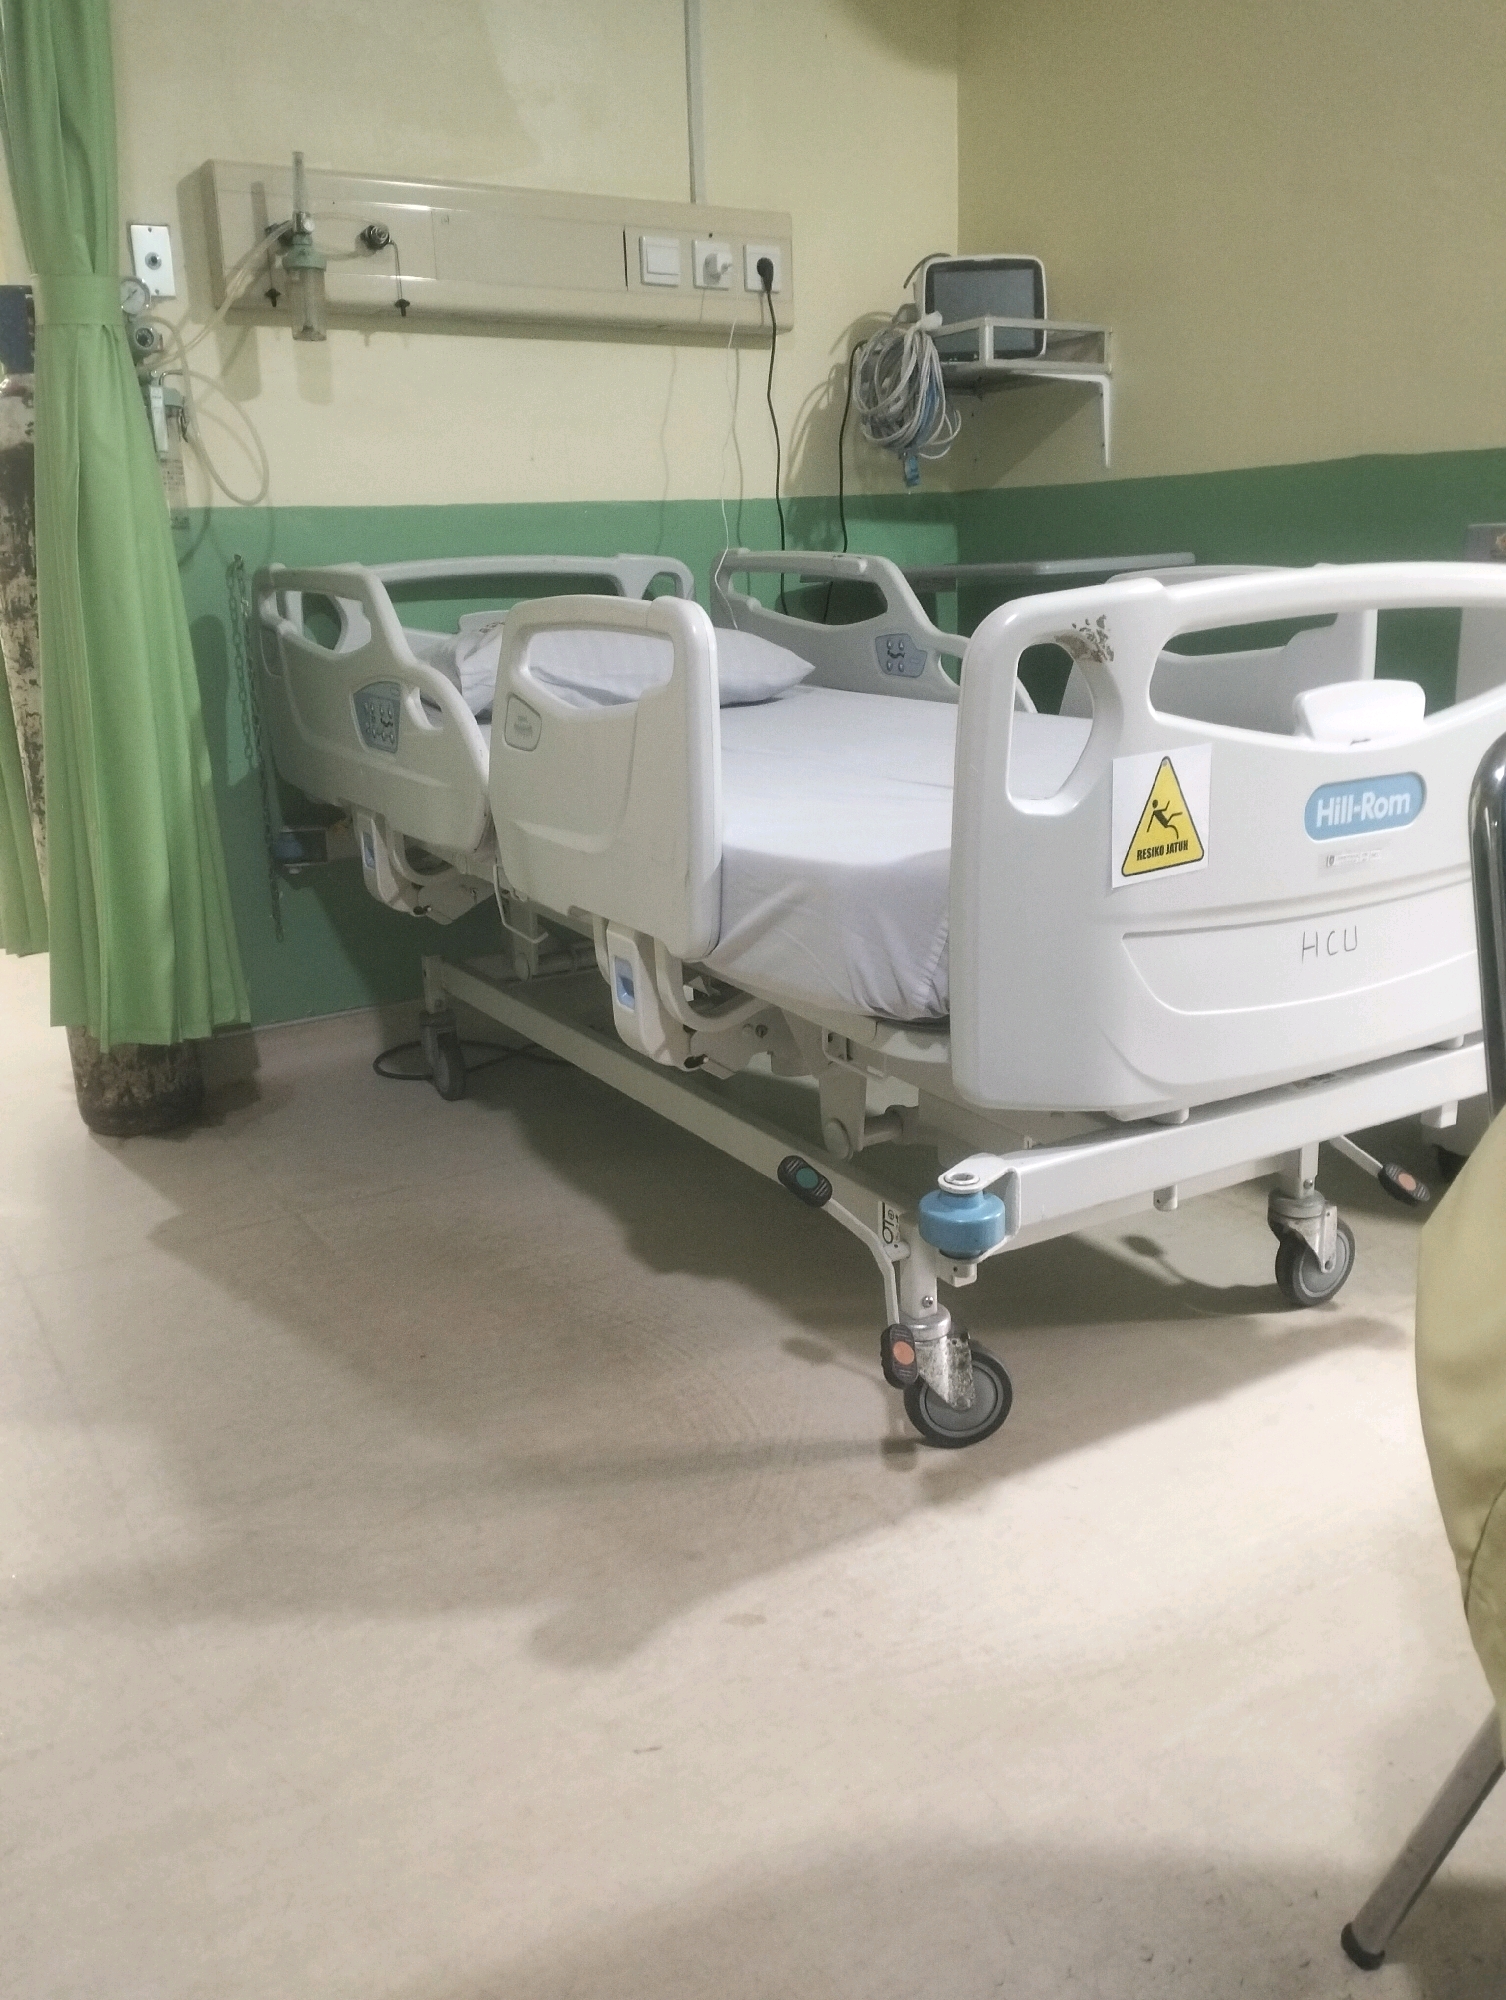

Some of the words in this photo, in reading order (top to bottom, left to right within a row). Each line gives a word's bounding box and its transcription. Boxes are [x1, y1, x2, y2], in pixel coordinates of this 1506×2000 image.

[1316, 791, 1411, 828] Hill-Rom
[1136, 844, 1165, 861] RESIKO
[1165, 839, 1189, 855] JATUH
[1301, 925, 1358, 964] HCU
